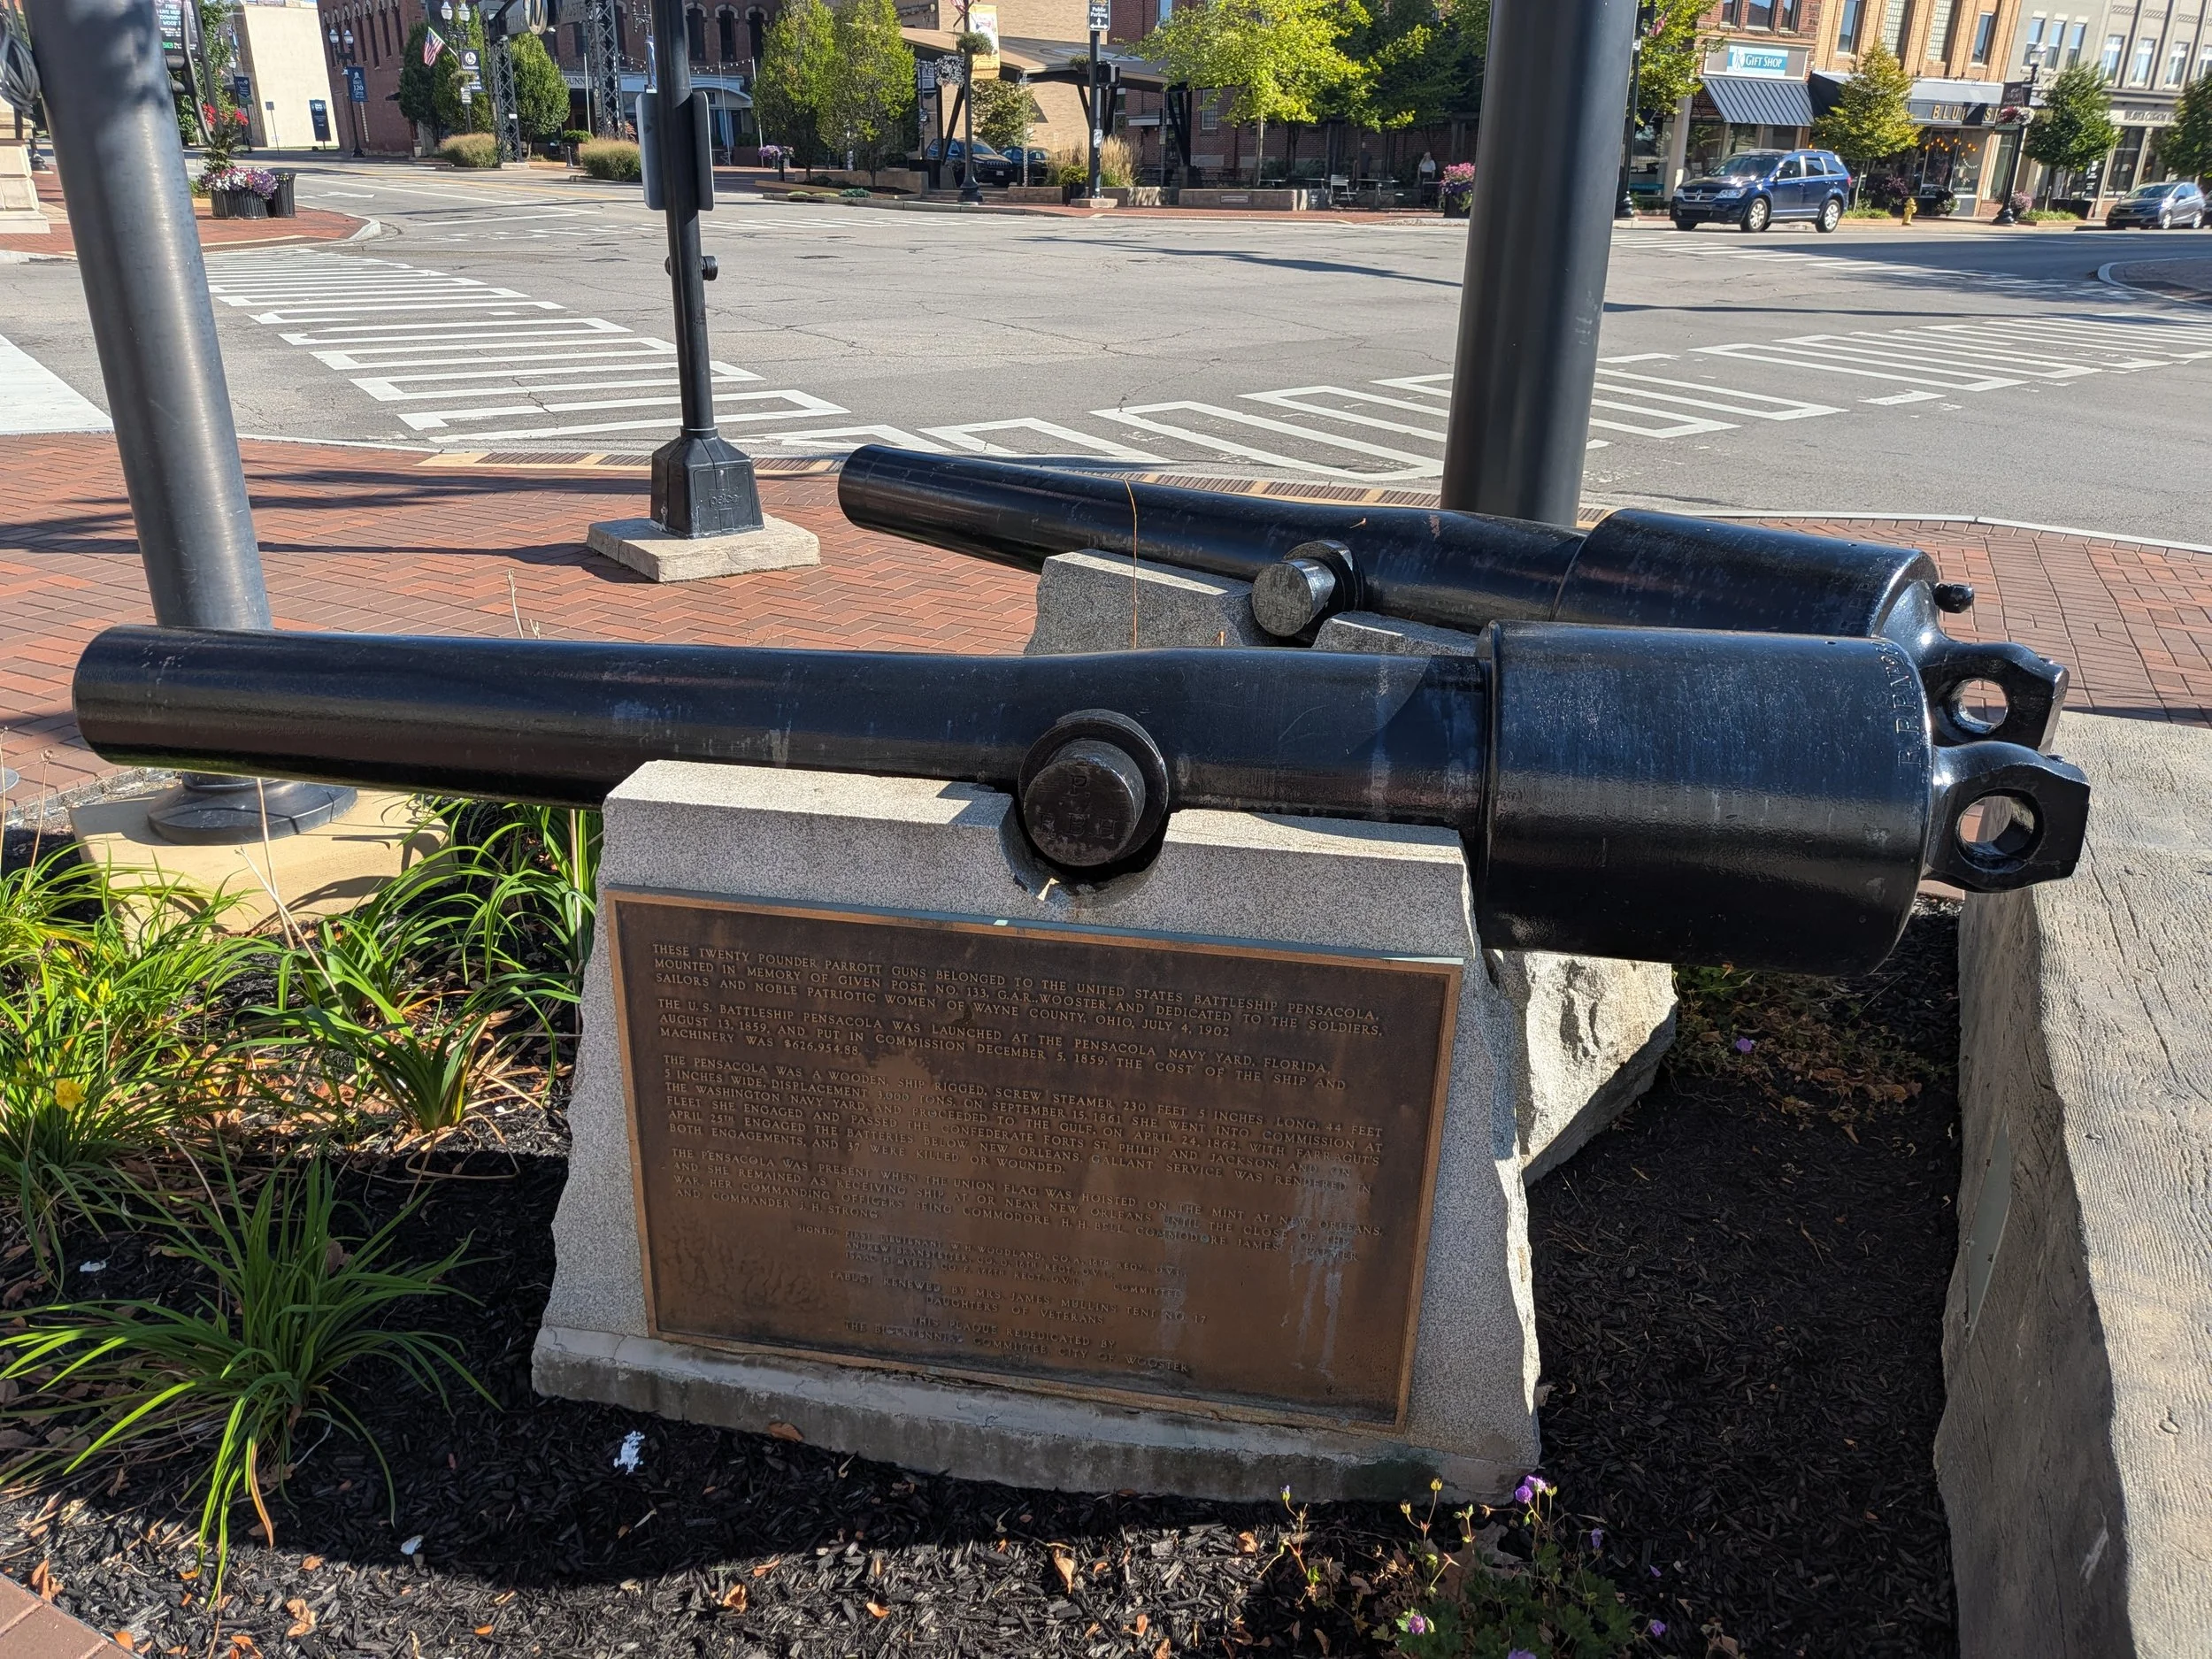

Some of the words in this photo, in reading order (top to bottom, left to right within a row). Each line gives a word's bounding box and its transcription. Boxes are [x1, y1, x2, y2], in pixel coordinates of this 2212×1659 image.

[1746, 55, 1763, 66] GIFT
[1763, 56, 1783, 68] SHOP
[652, 943, 689, 957] THESE
[699, 948, 749, 963] TWENTY
[758, 953, 817, 969] POUNDER
[825, 959, 882, 975] PARROTT
[891, 965, 926, 979] GUNS
[935, 969, 1005, 987] BELONGED
[1013, 976, 1033, 989] TO
[1041, 979, 1066, 992] THE
[1077, 982, 1125, 997] UNITED
[1134, 987, 1183, 1002] STATES
[1194, 993, 1278, 1011] BATTLESHIP
[654, 957, 714, 973] MOUNTED
[722, 964, 735, 975] IN
[746, 966, 801, 981] MEMORY
[810, 972, 828, 984] OF
[837, 974, 880, 989] GIVEN
[1115, 1001, 1144, 1014] AND
[1156, 1004, 1232, 1022] DEDICATED
[1242, 1012, 1262, 1025] TO
[1270, 1015, 1298, 1028] THE
[656, 972, 709, 987] SAILORS
[718, 978, 746, 991] AND
[755, 981, 797, 995] NOBLE
[807, 987, 876, 1003] PATRIOTIC
[884, 994, 935, 1009] WOMEN
[946, 1000, 964, 1011] OF
[972, 1002, 1018, 1017] WAYNE
[1141, 1018, 1172, 1032] JULY
[1198, 1024, 1229, 1037] 1902
[657, 997, 680, 1010] THE
[719, 1003, 794, 1021] BATTLESHIP
[803, 1011, 882, 1030] PENSACOLA
[892, 1020, 920, 1033] WAS
[932, 1024, 1002, 1041] LAUNCHED
[1011, 1032, 1028, 1044] AT
[1038, 1034, 1062, 1048] THE
[1074, 1038, 1156, 1056] PENSACOLA
[1168, 1048, 1206, 1062] NAVY
[658, 1011, 709, 1027] AUGUST
[777, 1024, 805, 1037] AND
[816, 1027, 840, 1041] PUT
[849, 1031, 864, 1042] IN
[874, 1033, 964, 1053] COMMISSION
[977, 1043, 1046, 1061] DECEMBER
[1116, 1056, 1142, 1071] THE
[1154, 1061, 1195, 1076] COST
[1204, 1065, 1225, 1079] OF
[1234, 1069, 1261, 1082] THE
[1272, 1072, 1307, 1087] SHIP
[1314, 1077, 1347, 1090] AND
[659, 1026, 734, 1043] MACHINERY
[745, 1034, 773, 1048] WAS
[663, 1053, 686, 1065] THE
[694, 1056, 768, 1074] PENSACOLA
[775, 1064, 802, 1078] WAS
[811, 1069, 821, 1079] A
[897, 1078, 925, 1090] SHIP
[995, 1087, 1042, 1102] SCREW
[1052, 1093, 1115, 1110] STEAMER
[1123, 1101, 1146, 1113] 230
[1156, 1104, 1187, 1118] FEET
[1197, 1108, 1205, 1119] 5
[1213, 1110, 1263, 1125] INCHES
[1325, 1121, 1341, 1133] 44
[1351, 1124, 1383, 1137] FEET
[664, 1068, 671, 1079] 5
[676, 1069, 723, 1084] INCHES
[771, 1079, 866, 1099] DISPLACEMENT
[963, 1098, 982, 1110] ON
[992, 1102, 1065, 1119] SEPTEMBER
[1094, 1112, 1121, 1125] 1861
[1132, 1116, 1157, 1129] SHE
[1168, 1119, 1204, 1133] WENT
[1216, 1125, 1249, 1138] INTO
[1262, 1129, 1355, 1149] COMMISSION
[1364, 1140, 1383, 1152] AT
[664, 1081, 687, 1094] THE
[695, 1084, 780, 1103] WASHINGTON
[790, 1094, 823, 1108] NAVY
[873, 1102, 902, 1116] AND
[911, 1107, 987, 1125] PROCEEDED
[996, 1116, 1014, 1127] TO
[1027, 1118, 1048, 1131] THE
[1102, 1126, 1122, 1139] ON
[1133, 1130, 1173, 1144] APRIL
[1248, 1142, 1285, 1156] WITH
[1295, 1147, 1379, 1165] FARRAGUT'S
[669, 1122, 702, 1136] BOTH
[811, 1137, 839, 1150] AND
[847, 1141, 860, 1153] 37
[869, 1143, 904, 1157] WERE
[916, 1148, 958, 1164] KILLED
[969, 1154, 988, 1166] OR
[828, 1270, 874, 1285] TABLET
[882, 1277, 941, 1293] RENEWED
[950, 1285, 967, 1295] BY
[1010, 1292, 1050, 1306] JAMES
[1060, 1298, 1118, 1314] MULLINS
[1193, 1313, 1208, 1325] 17
[912, 1316, 940, 1328] THIS
[948, 1320, 998, 1335] PLAQUE
[1005, 1327, 1091, 1346] REDEDICATED
[1100, 1338, 1117, 1349] BY
